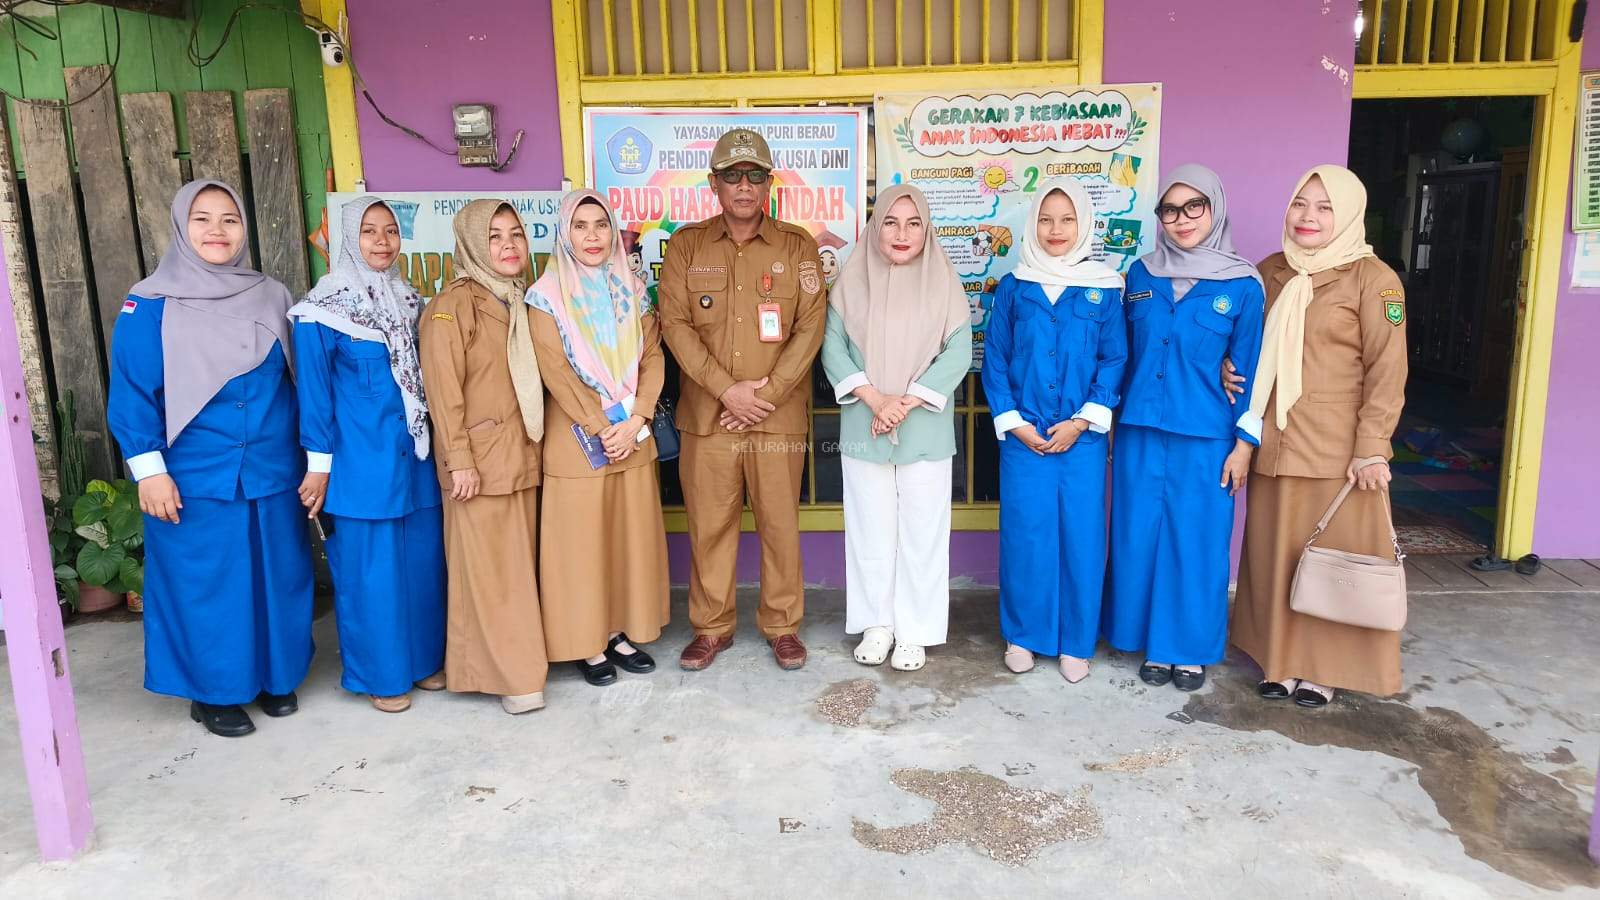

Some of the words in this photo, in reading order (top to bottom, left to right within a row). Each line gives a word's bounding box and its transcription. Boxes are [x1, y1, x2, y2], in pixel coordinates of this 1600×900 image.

[928, 108, 1009, 125] GERAKAN
[1014, 105, 1025, 122] 7
[673, 126, 724, 139] YAYASAN
[767, 126, 793, 139] PURI
[797, 126, 835, 139] BERAU
[920, 129, 964, 146] ANAK
[1062, 123, 1113, 141] HEBAT
[659, 150, 712, 169] PENDIDI
[786, 150, 817, 168] USIA
[822, 150, 849, 168] DINI
[911, 168, 949, 179] BANGUN
[1023, 166, 1039, 192] 2
[608, 187, 664, 221] PAUD
[777, 187, 845, 221] INDAH
[937, 226, 977, 237] AHRAGA
